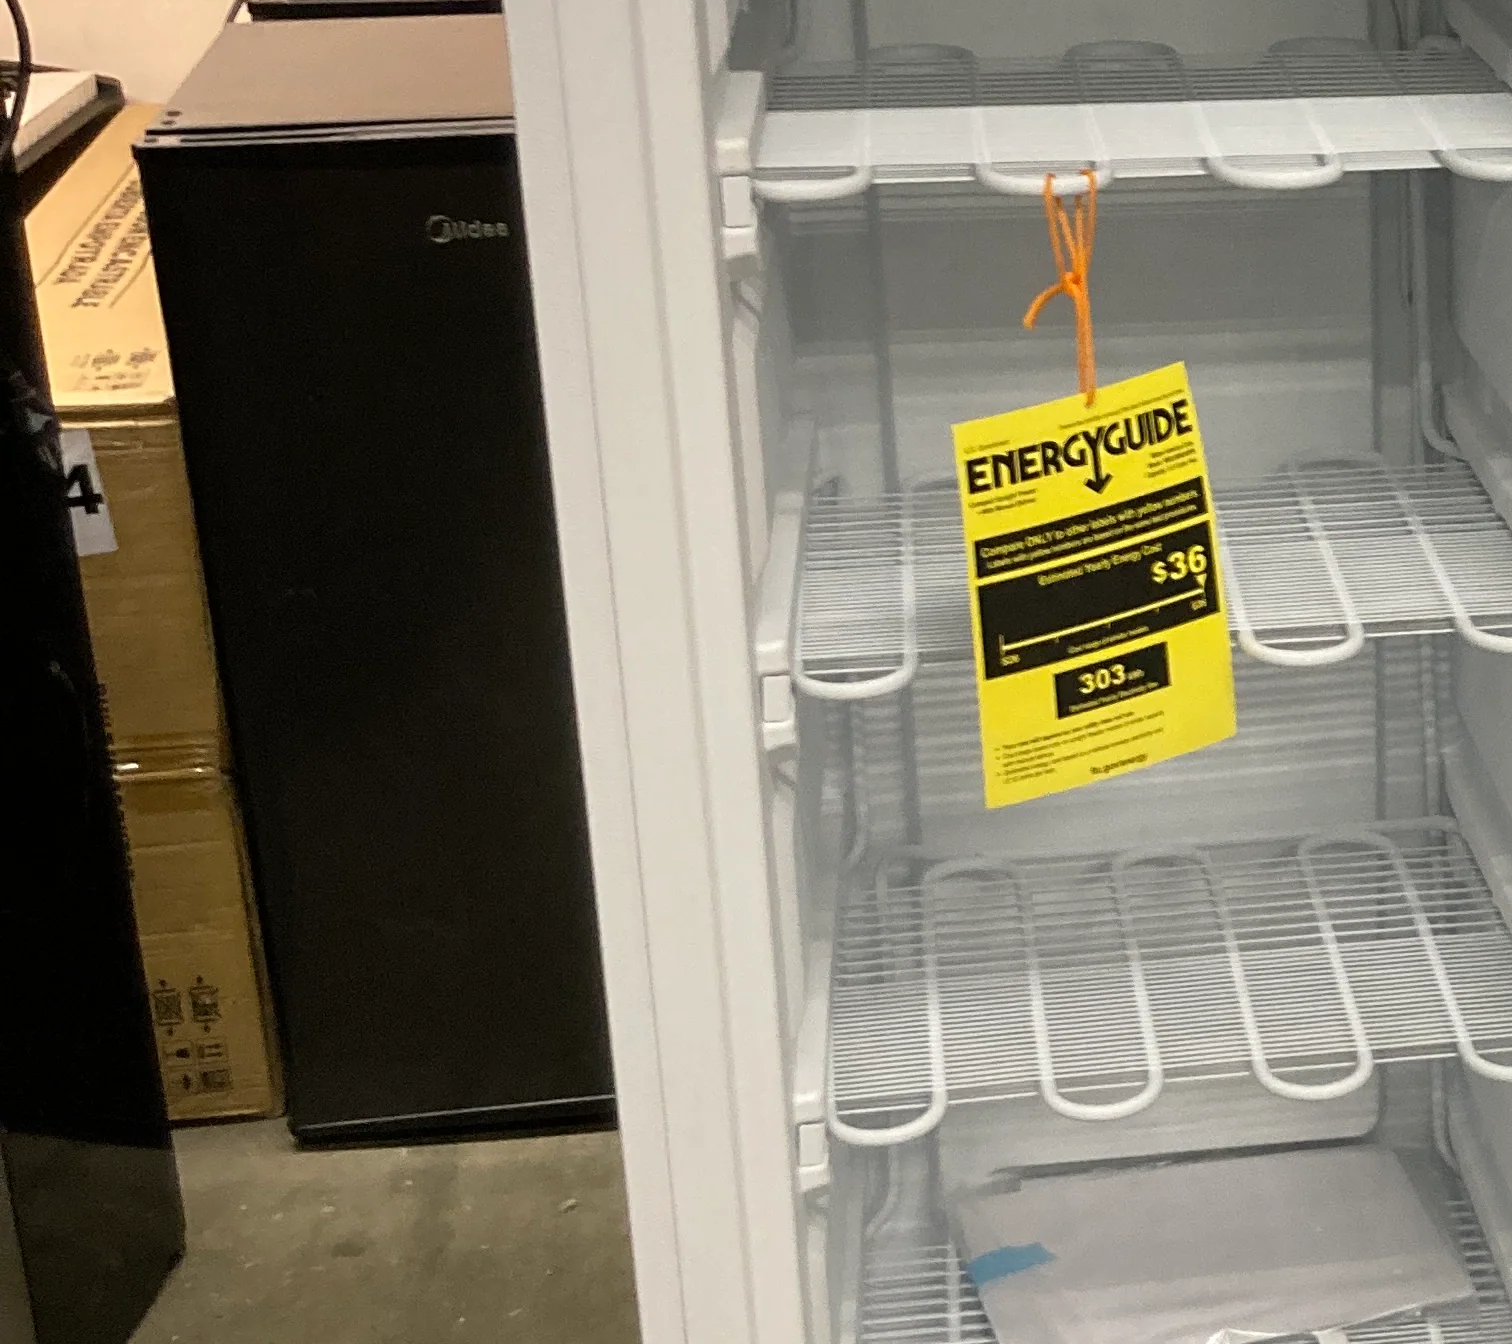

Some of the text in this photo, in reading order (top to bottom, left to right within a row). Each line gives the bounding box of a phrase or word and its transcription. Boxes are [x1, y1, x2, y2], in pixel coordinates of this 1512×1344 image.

[965, 398, 1194, 495] ENERGYGUIDE
[63, 463, 104, 514] 4
[1152, 544, 1208, 585] $36
[1078, 663, 1127, 695] 303
